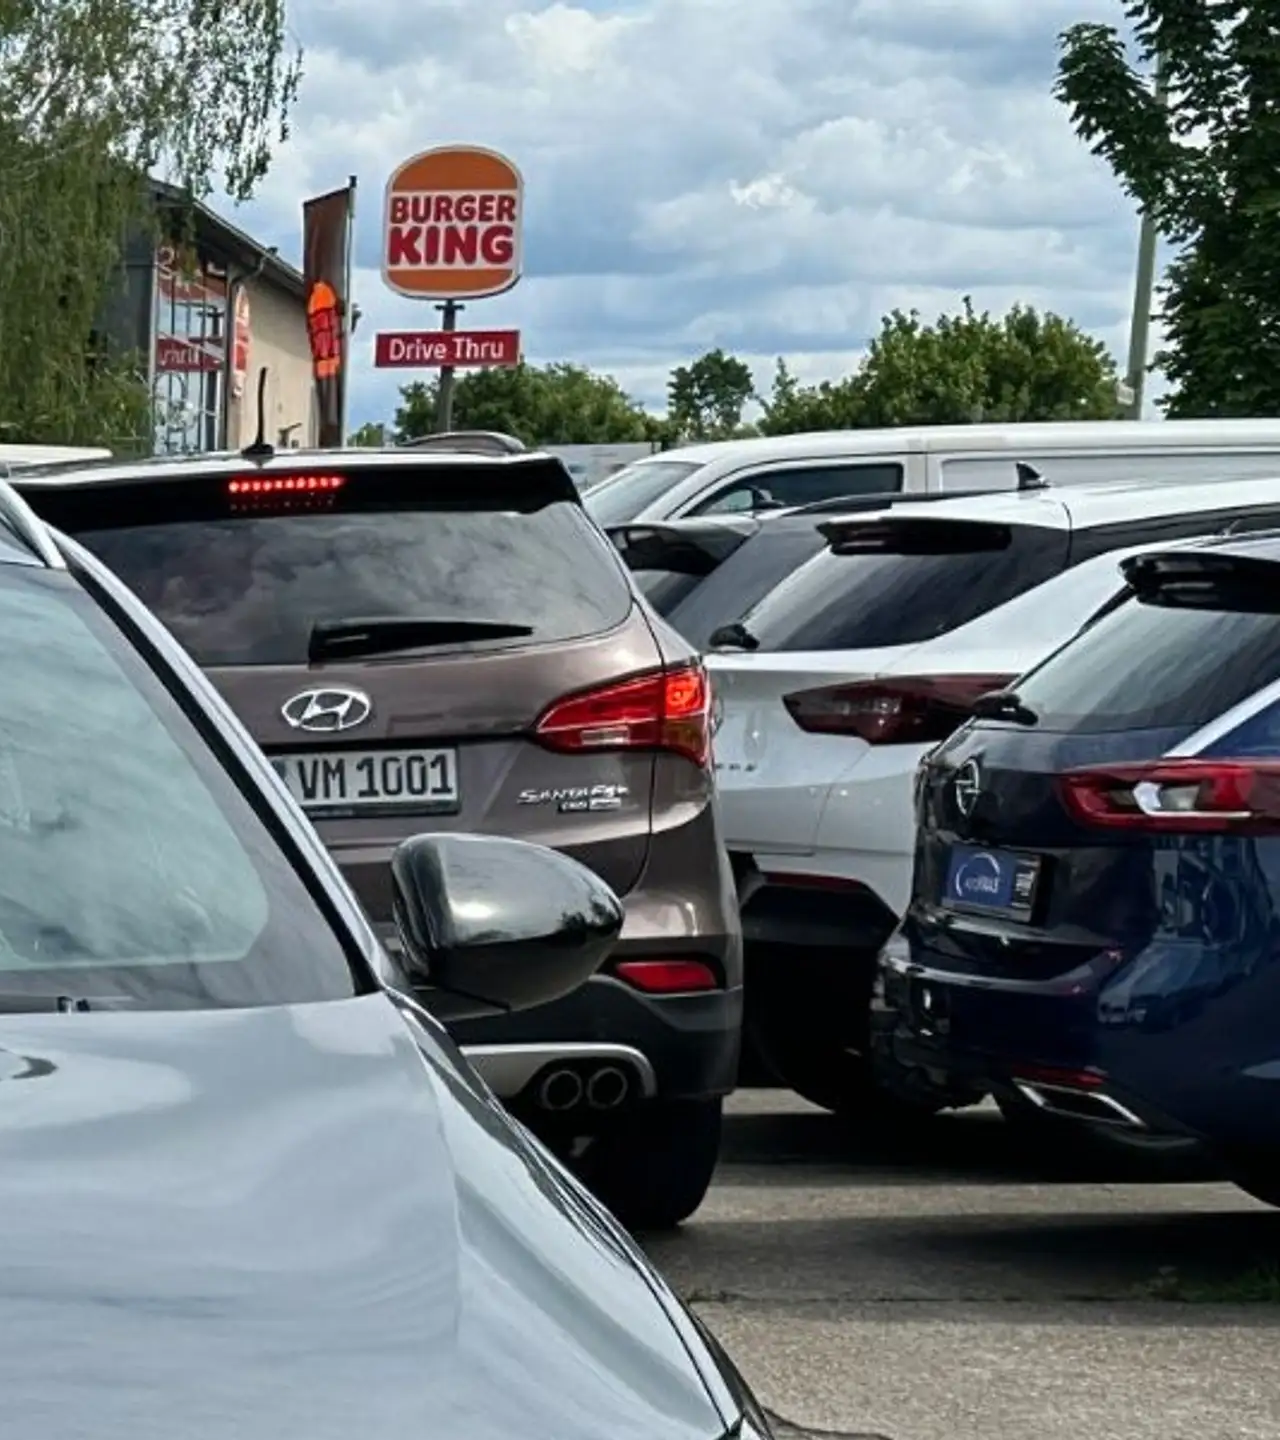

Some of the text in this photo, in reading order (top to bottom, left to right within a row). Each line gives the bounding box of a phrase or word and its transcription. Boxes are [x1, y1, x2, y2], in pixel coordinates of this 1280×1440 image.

[390, 194, 516, 224] BURGER
[388, 224, 514, 265] KING
[389, 337, 504, 361] Drive Thru
[297, 755, 452, 799] VM 1001
